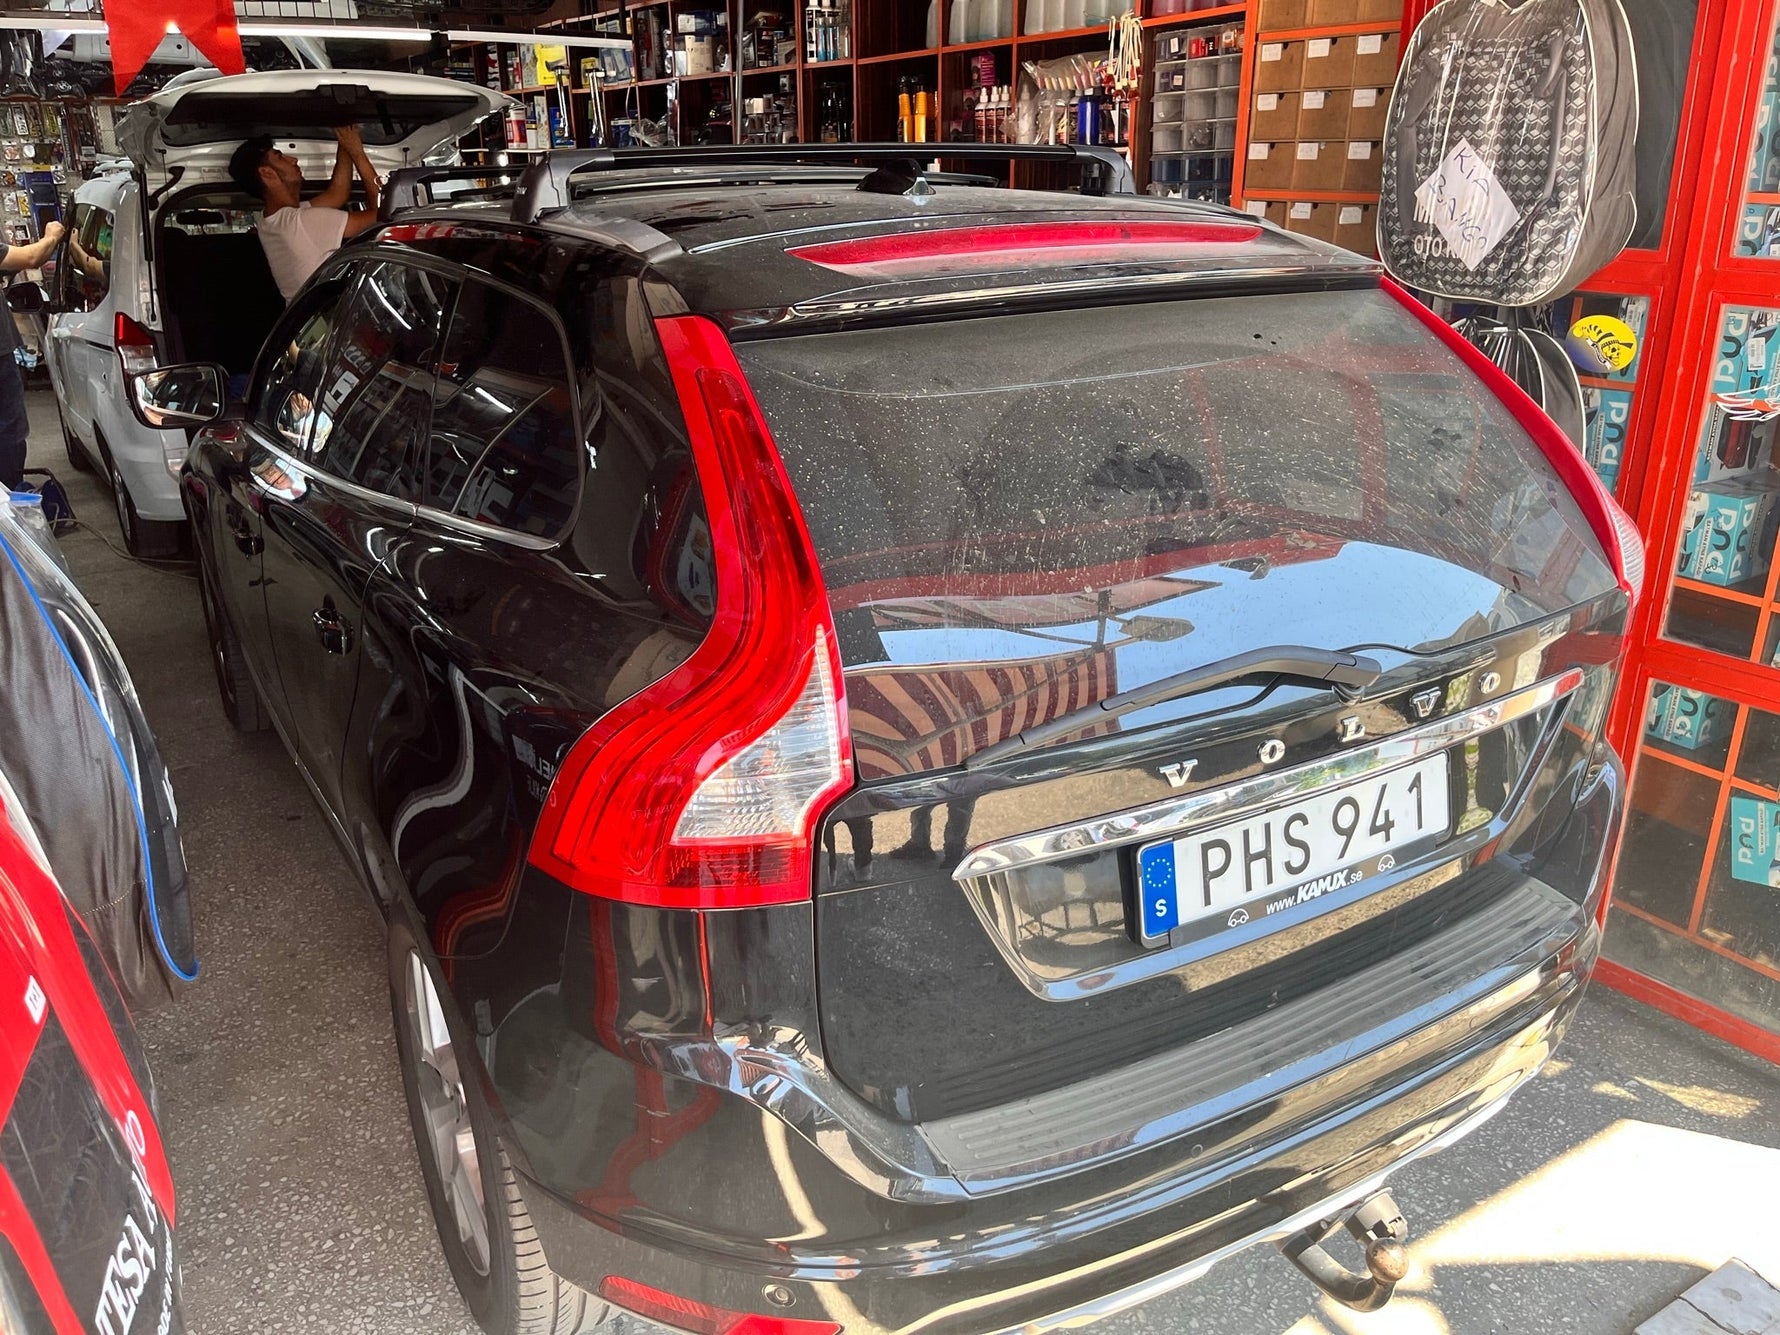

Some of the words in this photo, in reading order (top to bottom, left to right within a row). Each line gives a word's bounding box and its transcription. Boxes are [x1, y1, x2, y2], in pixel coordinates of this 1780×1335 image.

[1157, 671, 1502, 788] VOLVO
[1200, 811, 1312, 908] PHS
[1331, 771, 1425, 860] 941
[1266, 868, 1363, 916] www.KAMUX.se
[1154, 898, 1168, 918] S
[95, 1213, 157, 1335] TESA
